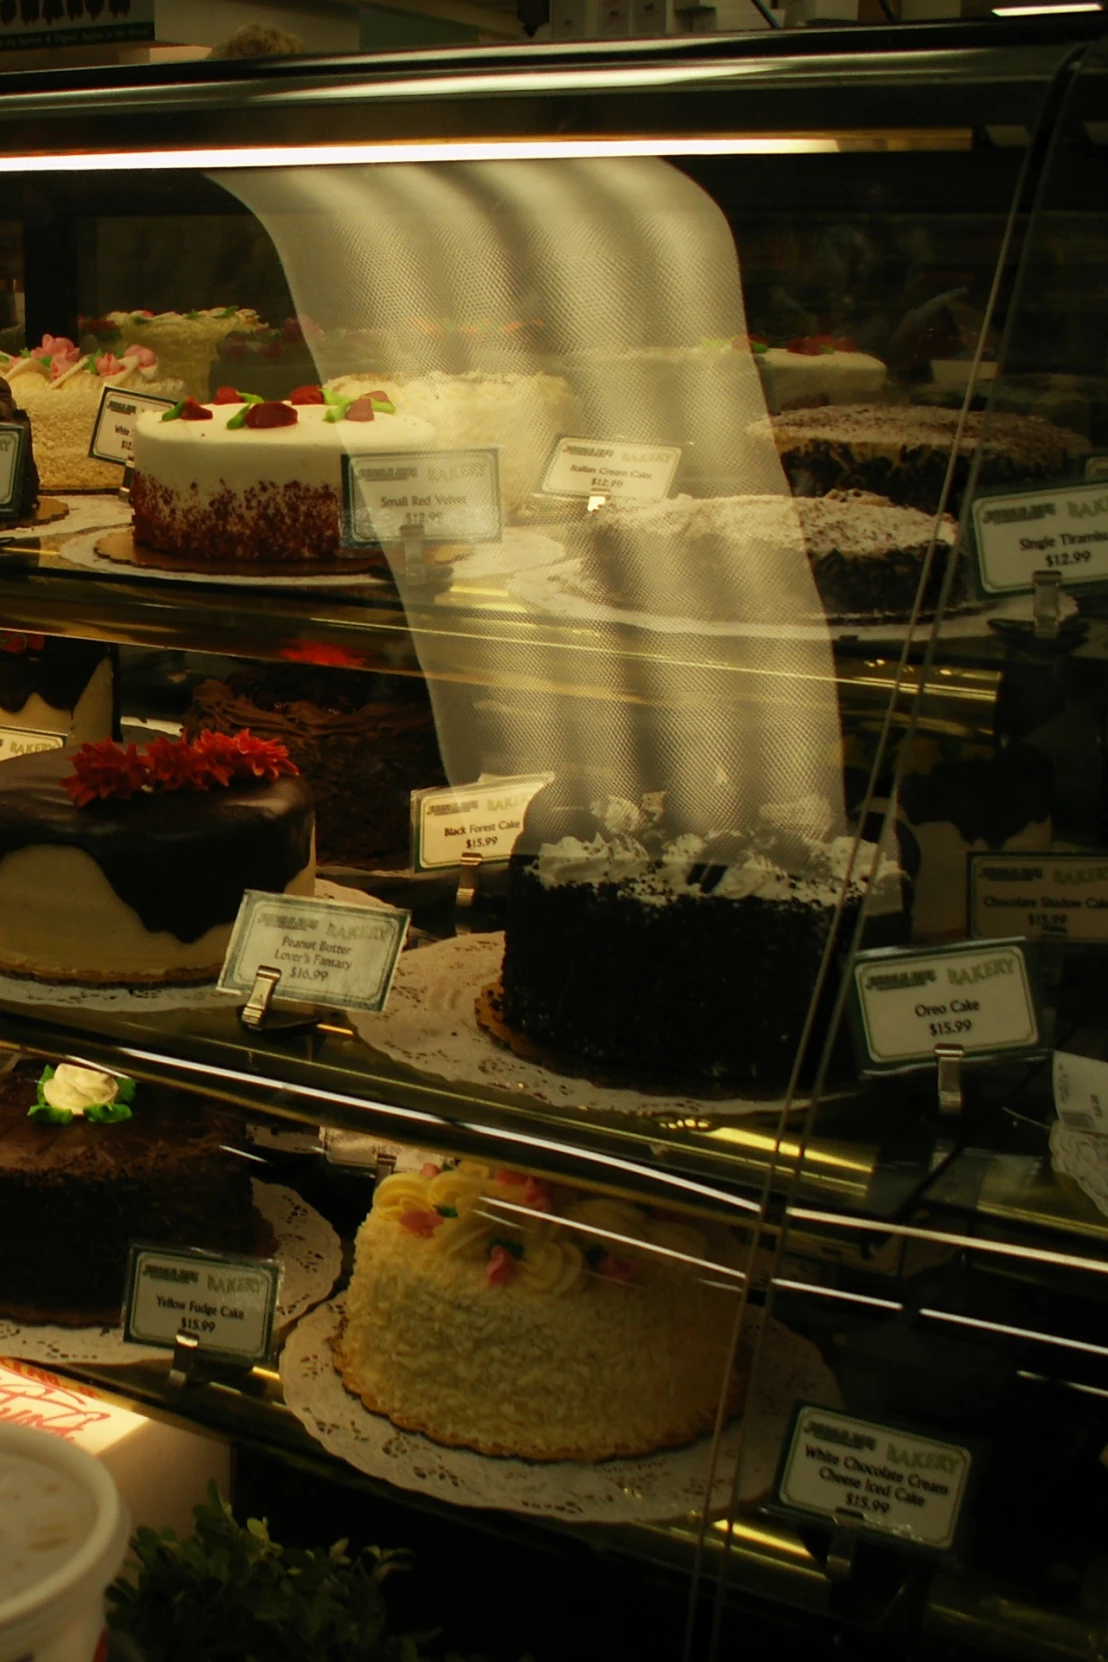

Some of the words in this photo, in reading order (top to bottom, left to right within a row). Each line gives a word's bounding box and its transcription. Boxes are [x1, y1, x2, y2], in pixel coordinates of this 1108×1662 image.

[380, 496, 408, 507] Small
[411, 496, 431, 506] Red
[1019, 536, 1055, 551] Single
[1045, 550, 1091, 567] $12.99
[444, 825, 466, 836] Black
[469, 823, 496, 834] Forest
[498, 820, 520, 830] Cake
[466, 836, 498, 849] $15.99
[983, 895, 1037, 907] Chocolate
[327, 922, 389, 942] BAKERY
[281, 935, 316, 950] Peanut
[318, 941, 352, 956] Butter
[274, 949, 310, 964] Lover's
[313, 954, 352, 970] Fantasy
[289, 966, 329, 981] $16.99
[947, 958, 1015, 985] BAKERY
[914, 1003, 946, 1017] Oreo
[949, 999, 980, 1013] Cake
[929, 1019, 972, 1036] $15.99
[207, 1274, 263, 1294] BAKERY
[156, 1296, 186, 1310] Yellow
[188, 1300, 217, 1316] Fudge
[220, 1306, 244, 1319] Cake
[181, 1317, 216, 1333] $15.99
[886, 1443, 959, 1474] BAKERY
[805, 1443, 840, 1465] White
[843, 1455, 904, 1483] Chocolate
[907, 1474, 949, 1496] Cream
[819, 1466, 861, 1489] Cheese
[864, 1479, 891, 1497] Iced
[894, 1487, 925, 1507] Cake
[845, 1492, 890, 1514] $15.99
